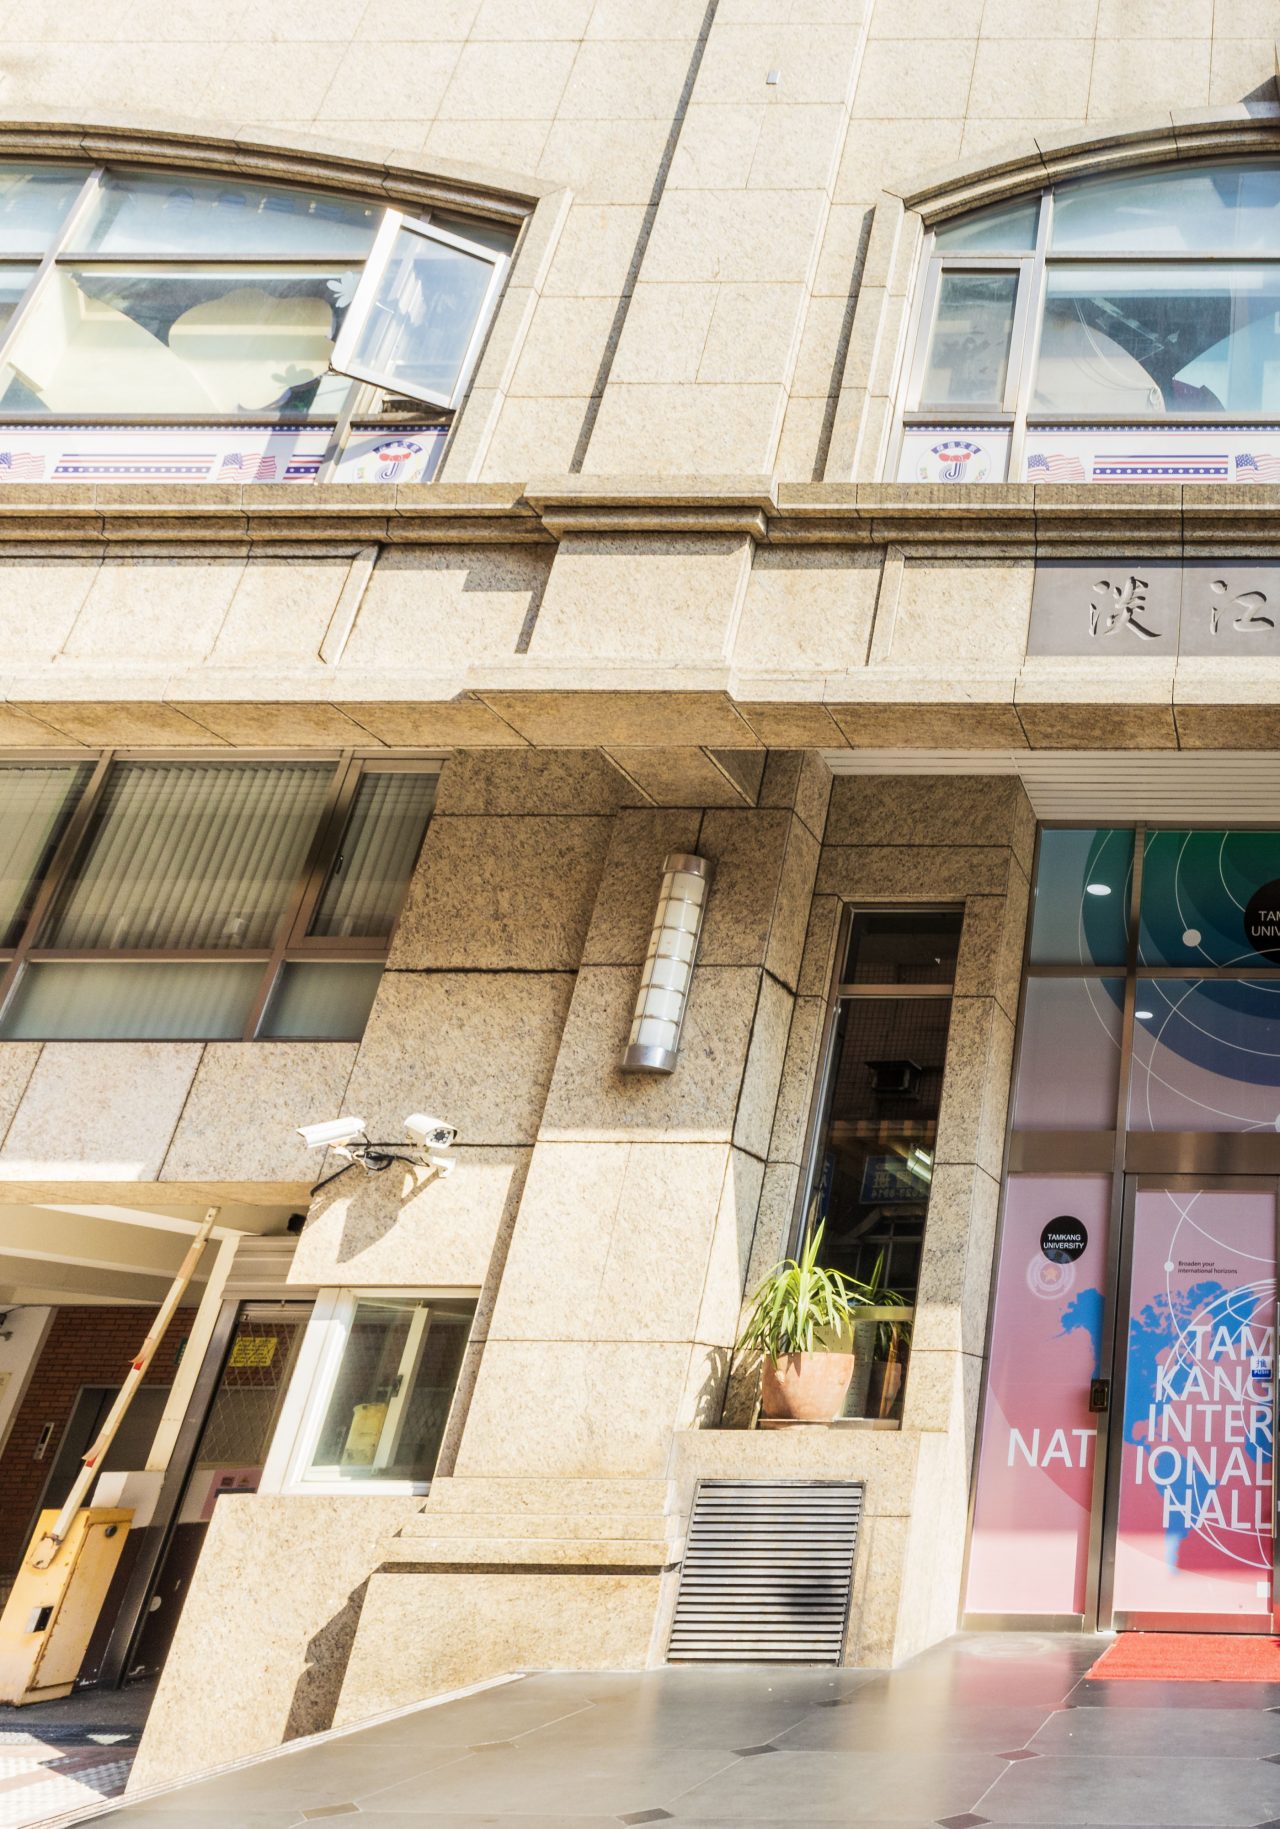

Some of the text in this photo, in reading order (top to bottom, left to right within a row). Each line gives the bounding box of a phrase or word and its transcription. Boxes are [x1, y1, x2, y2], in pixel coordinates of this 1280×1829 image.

[1047, 1233, 1081, 1241] TAMKANG
[1189, 1325, 1274, 1361] TAM
[1155, 1365, 1274, 1402] KANG
[1147, 1404, 1273, 1443] INTER
[1007, 1428, 1098, 1468] NAT
[1135, 1446, 1272, 1486] IONAL
[1162, 1489, 1272, 1529] HALL
